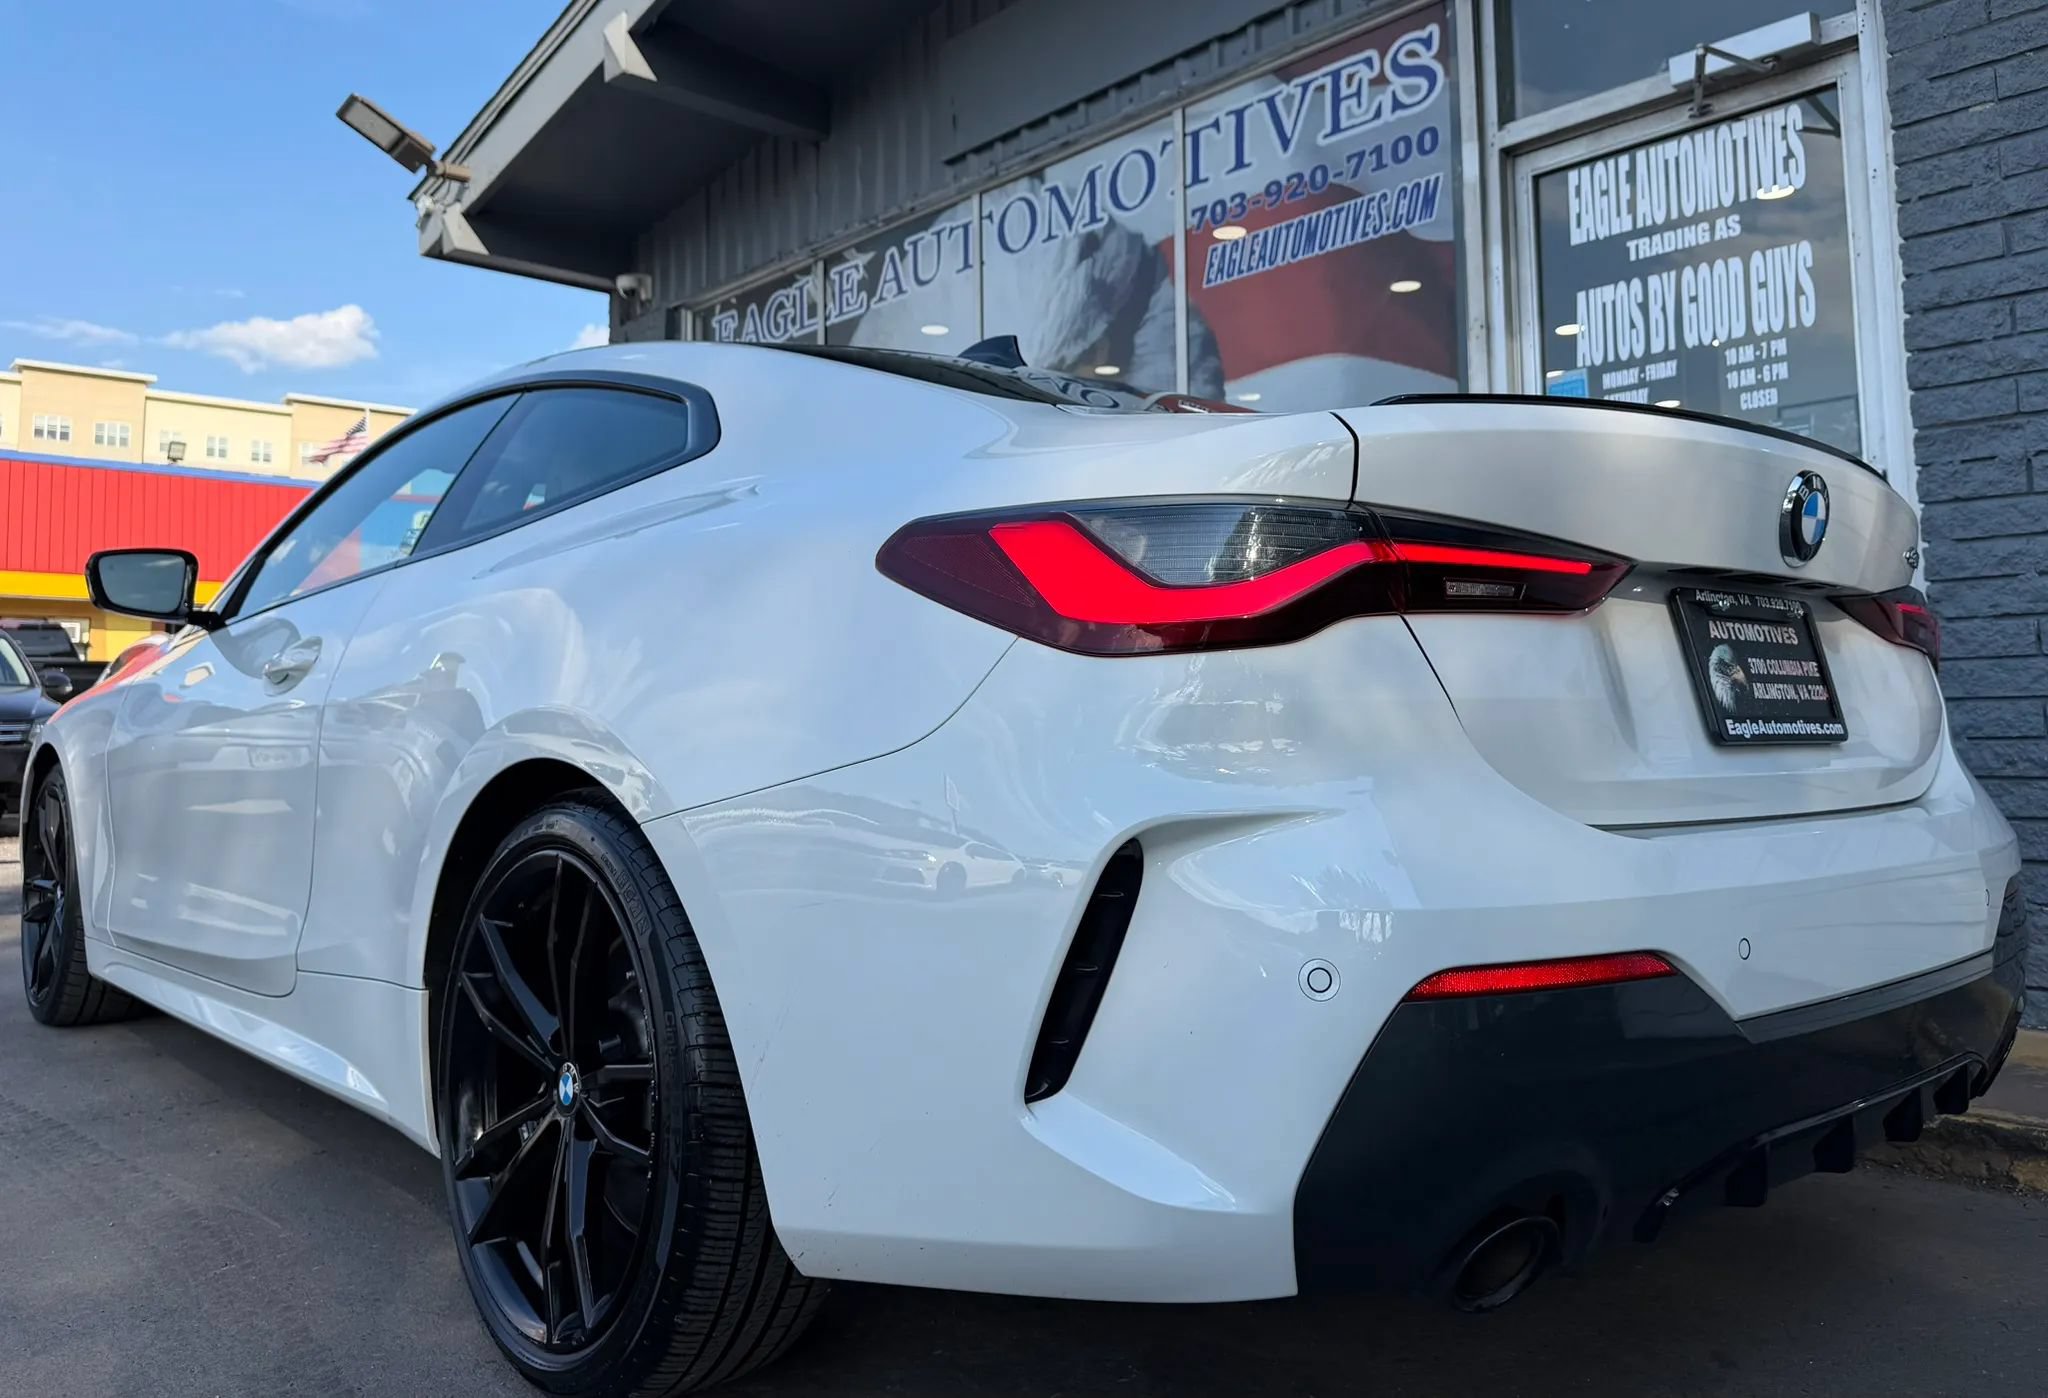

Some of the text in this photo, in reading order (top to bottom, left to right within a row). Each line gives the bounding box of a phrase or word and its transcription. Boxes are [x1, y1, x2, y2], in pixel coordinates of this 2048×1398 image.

[712, 24, 1442, 344] EAGLE AUTOMOTIVES
[1190, 125, 1440, 235] 703-920-7100
[1568, 103, 1806, 247] EAGLE AUTOMOTIVES
[1202, 172, 1444, 289] EAGLEAUTOMOTIVES.COM
[1626, 213, 1742, 262] TRADING AS
[1576, 240, 1816, 368] AUTOS BY GOOD GUYS
[1724, 347, 1737, 366] 10
[1738, 343, 1755, 364] AM
[1770, 337, 1788, 358] PM
[1602, 366, 1640, 390] MONDAY
[1645, 359, 1678, 382] FRIDAY
[1726, 370, 1739, 389] 10
[1740, 366, 1757, 387] AM
[1763, 364, 1771, 383] 6
[1772, 361, 1789, 381] PM
[1740, 387, 1779, 411] CLOSED
[1708, 620, 1799, 646] AUTOMOTIVES
[1797, 684, 1811, 700] VA
[1725, 718, 1845, 739] EagleAutomotives.com
